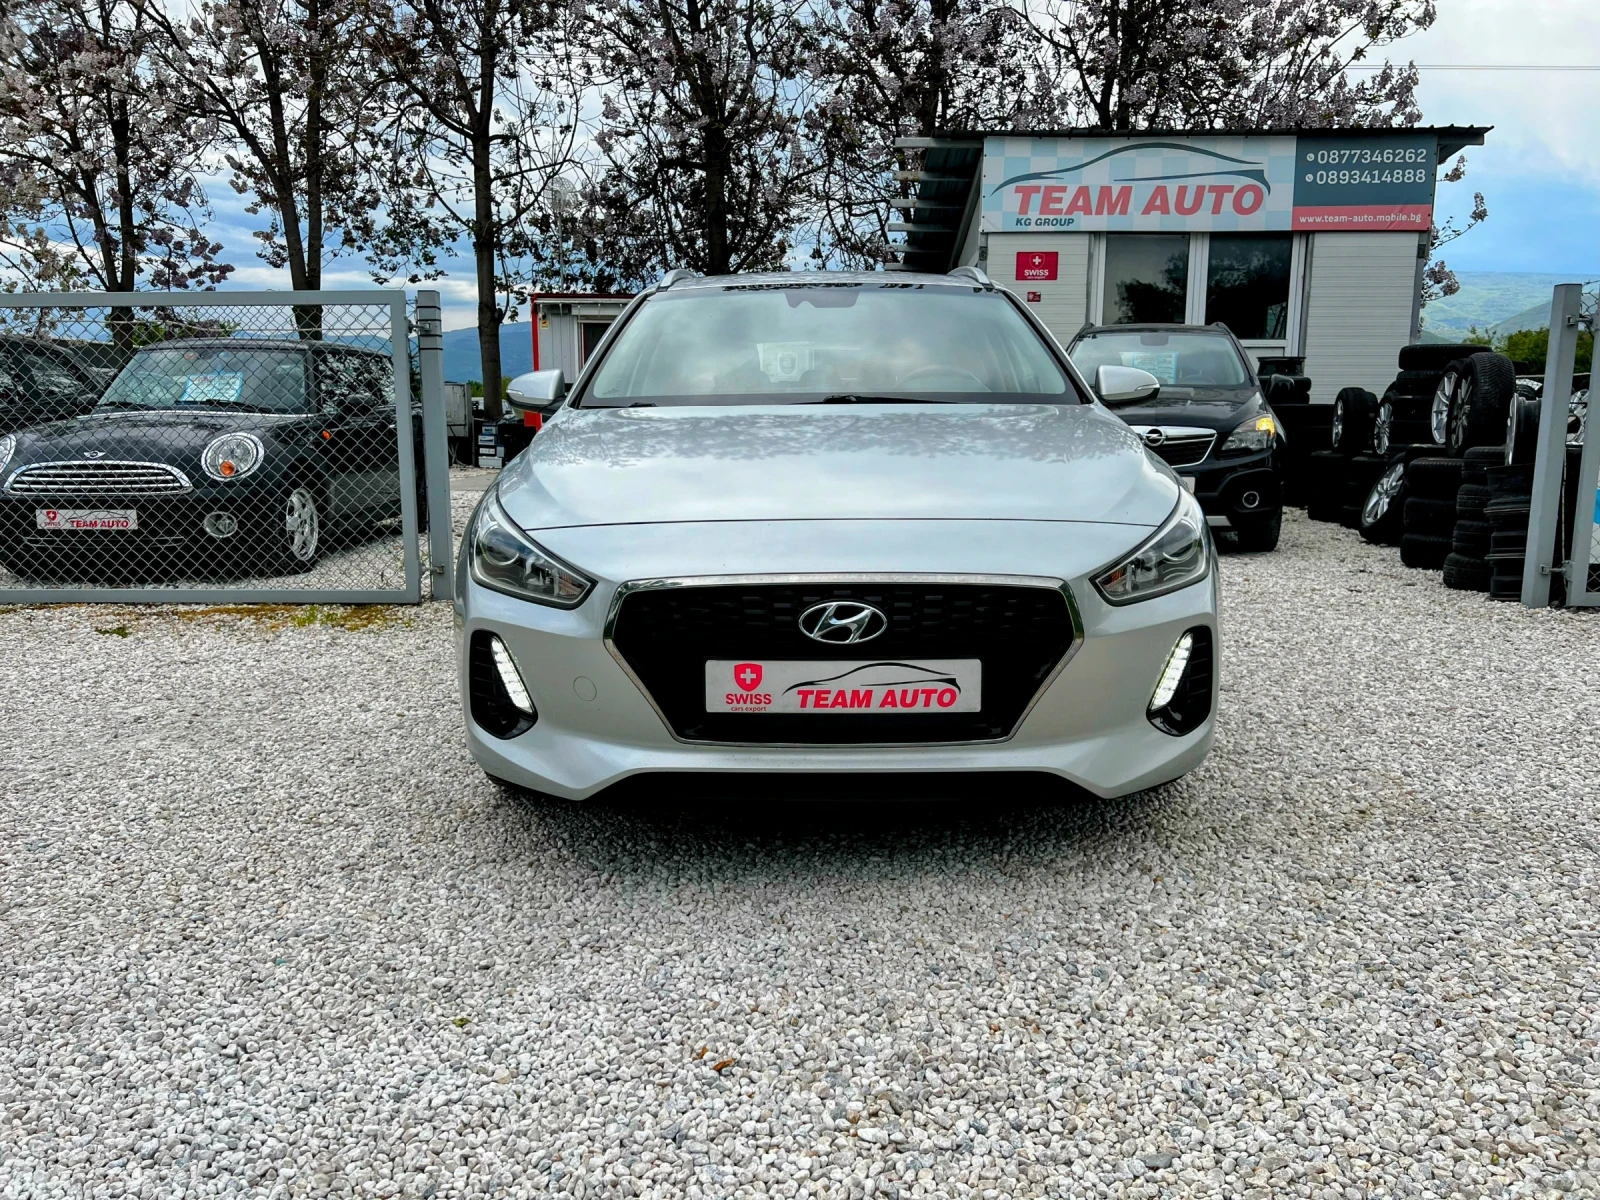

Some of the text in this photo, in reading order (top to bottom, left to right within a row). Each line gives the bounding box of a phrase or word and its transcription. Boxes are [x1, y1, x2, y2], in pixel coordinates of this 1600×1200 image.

[1317, 149, 1427, 164] 0877346262
[1316, 169, 1426, 185] 0893414888
[1014, 184, 1264, 216] TEAM AUTO
[1015, 217, 1075, 227] KG GROUP
[1299, 213, 1421, 222] www.team-auto.mobile.bg
[69, 520, 129, 528] TEAM AUTO
[725, 693, 772, 704] SWISS
[797, 688, 957, 708] TEAM AUTO
